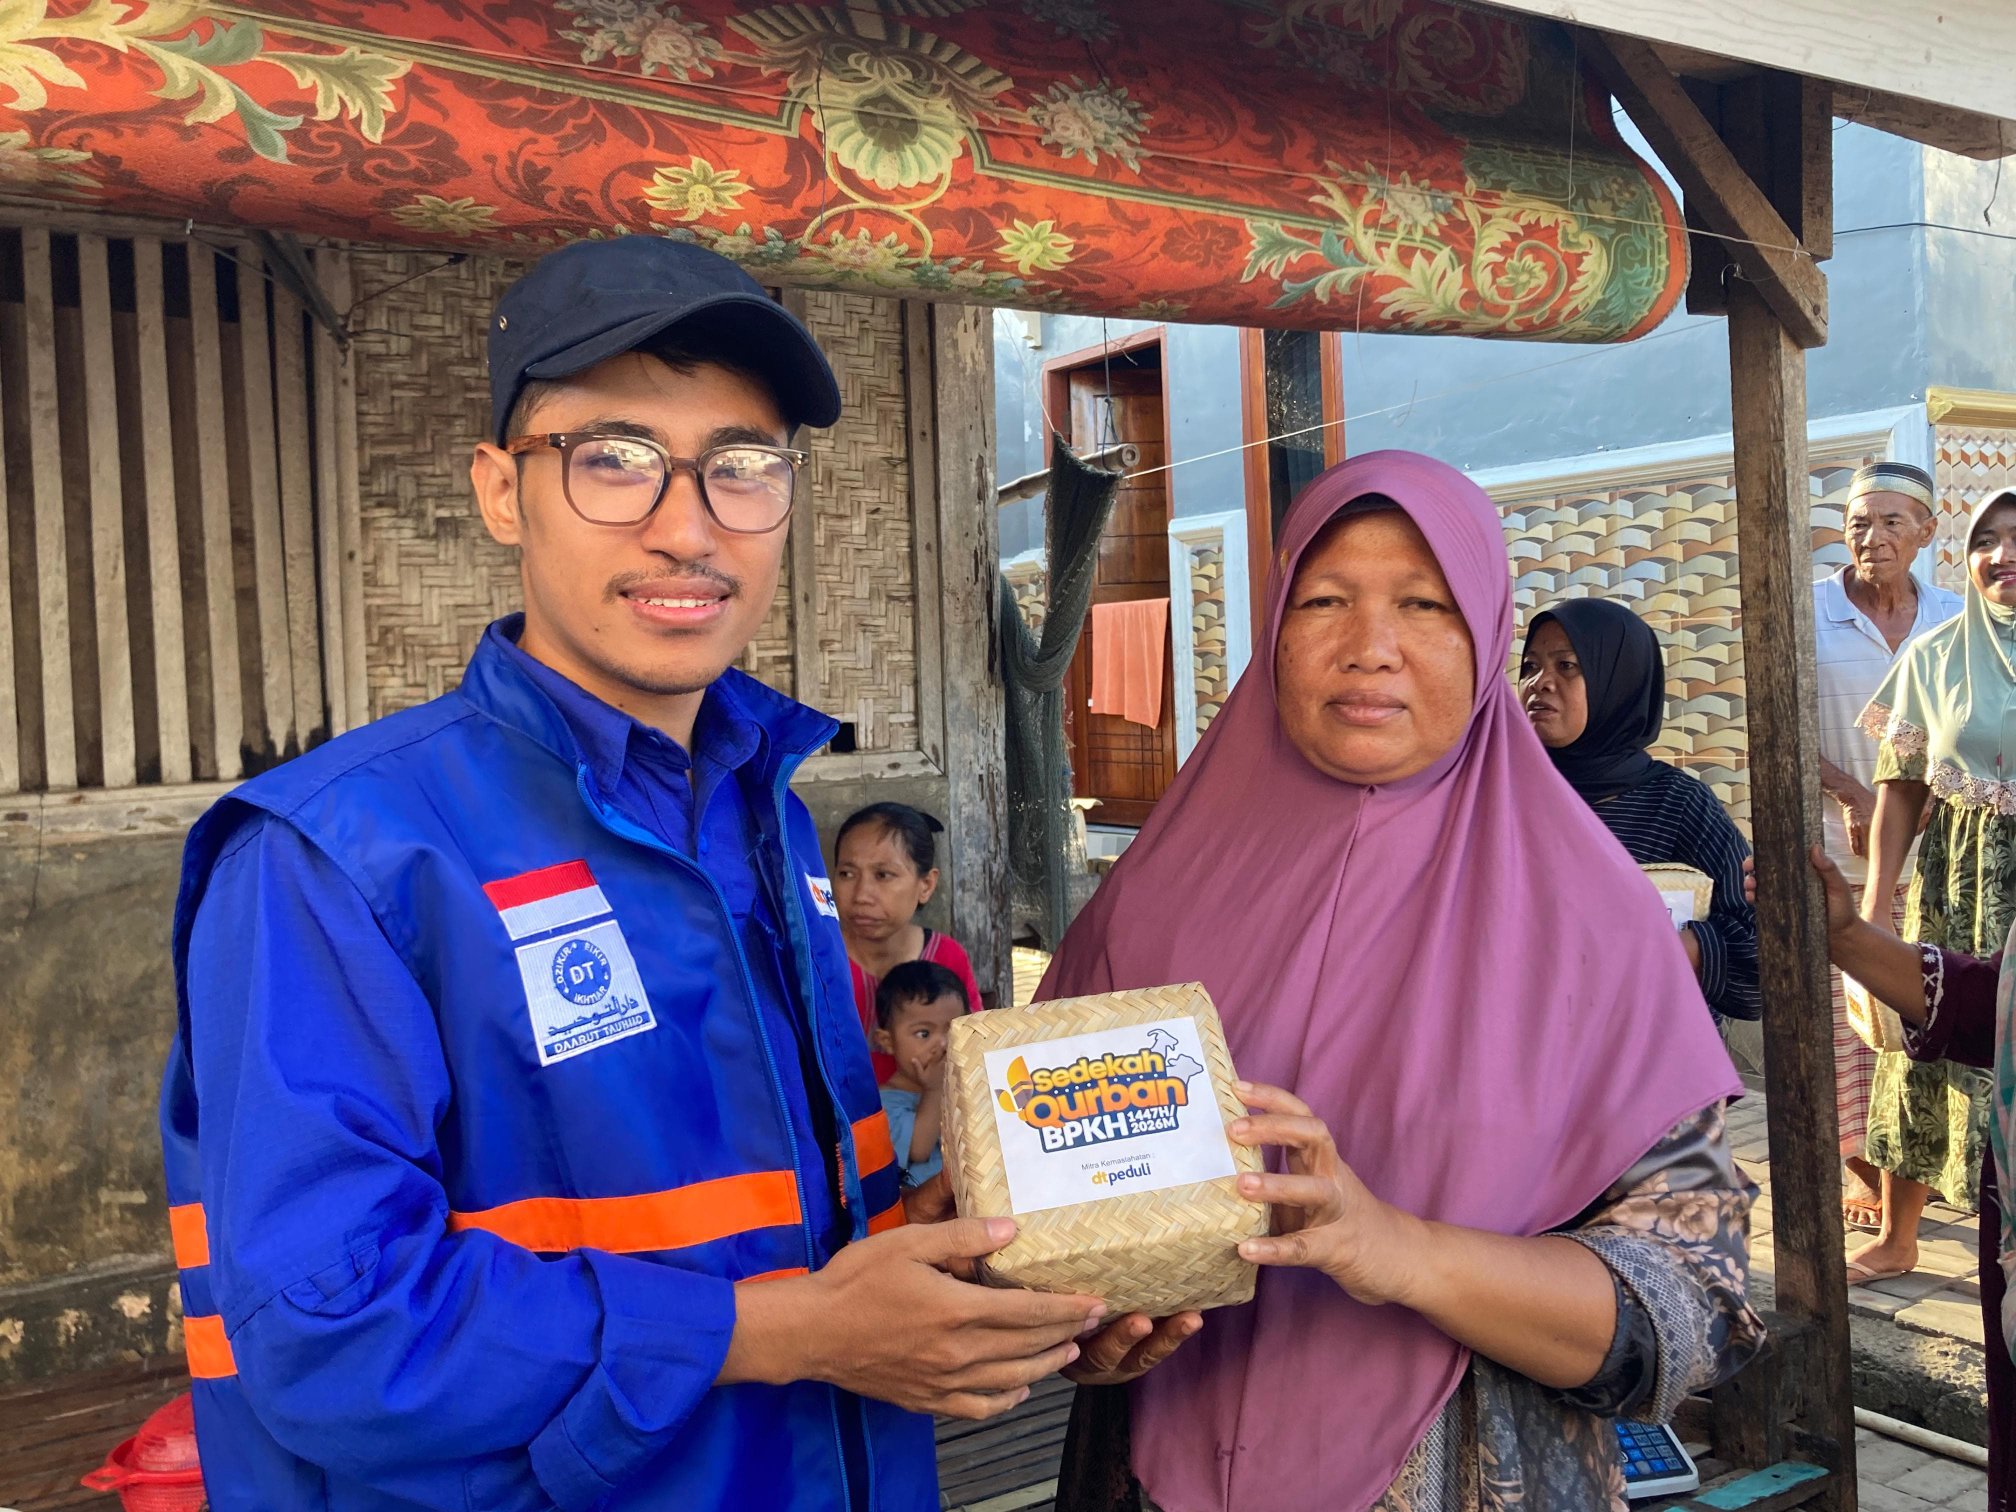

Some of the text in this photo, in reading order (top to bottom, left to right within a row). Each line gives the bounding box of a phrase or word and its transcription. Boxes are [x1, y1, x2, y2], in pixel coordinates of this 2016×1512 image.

[569, 960, 594, 985] DT
[554, 1030, 600, 1053] DAARUT
[1025, 1077, 1187, 1128] Qurban
[1042, 1104, 1175, 1150] BPKH 1447H/
[1130, 1117, 1177, 1134] 2026M
[1081, 1163, 1100, 1171] Mitra
